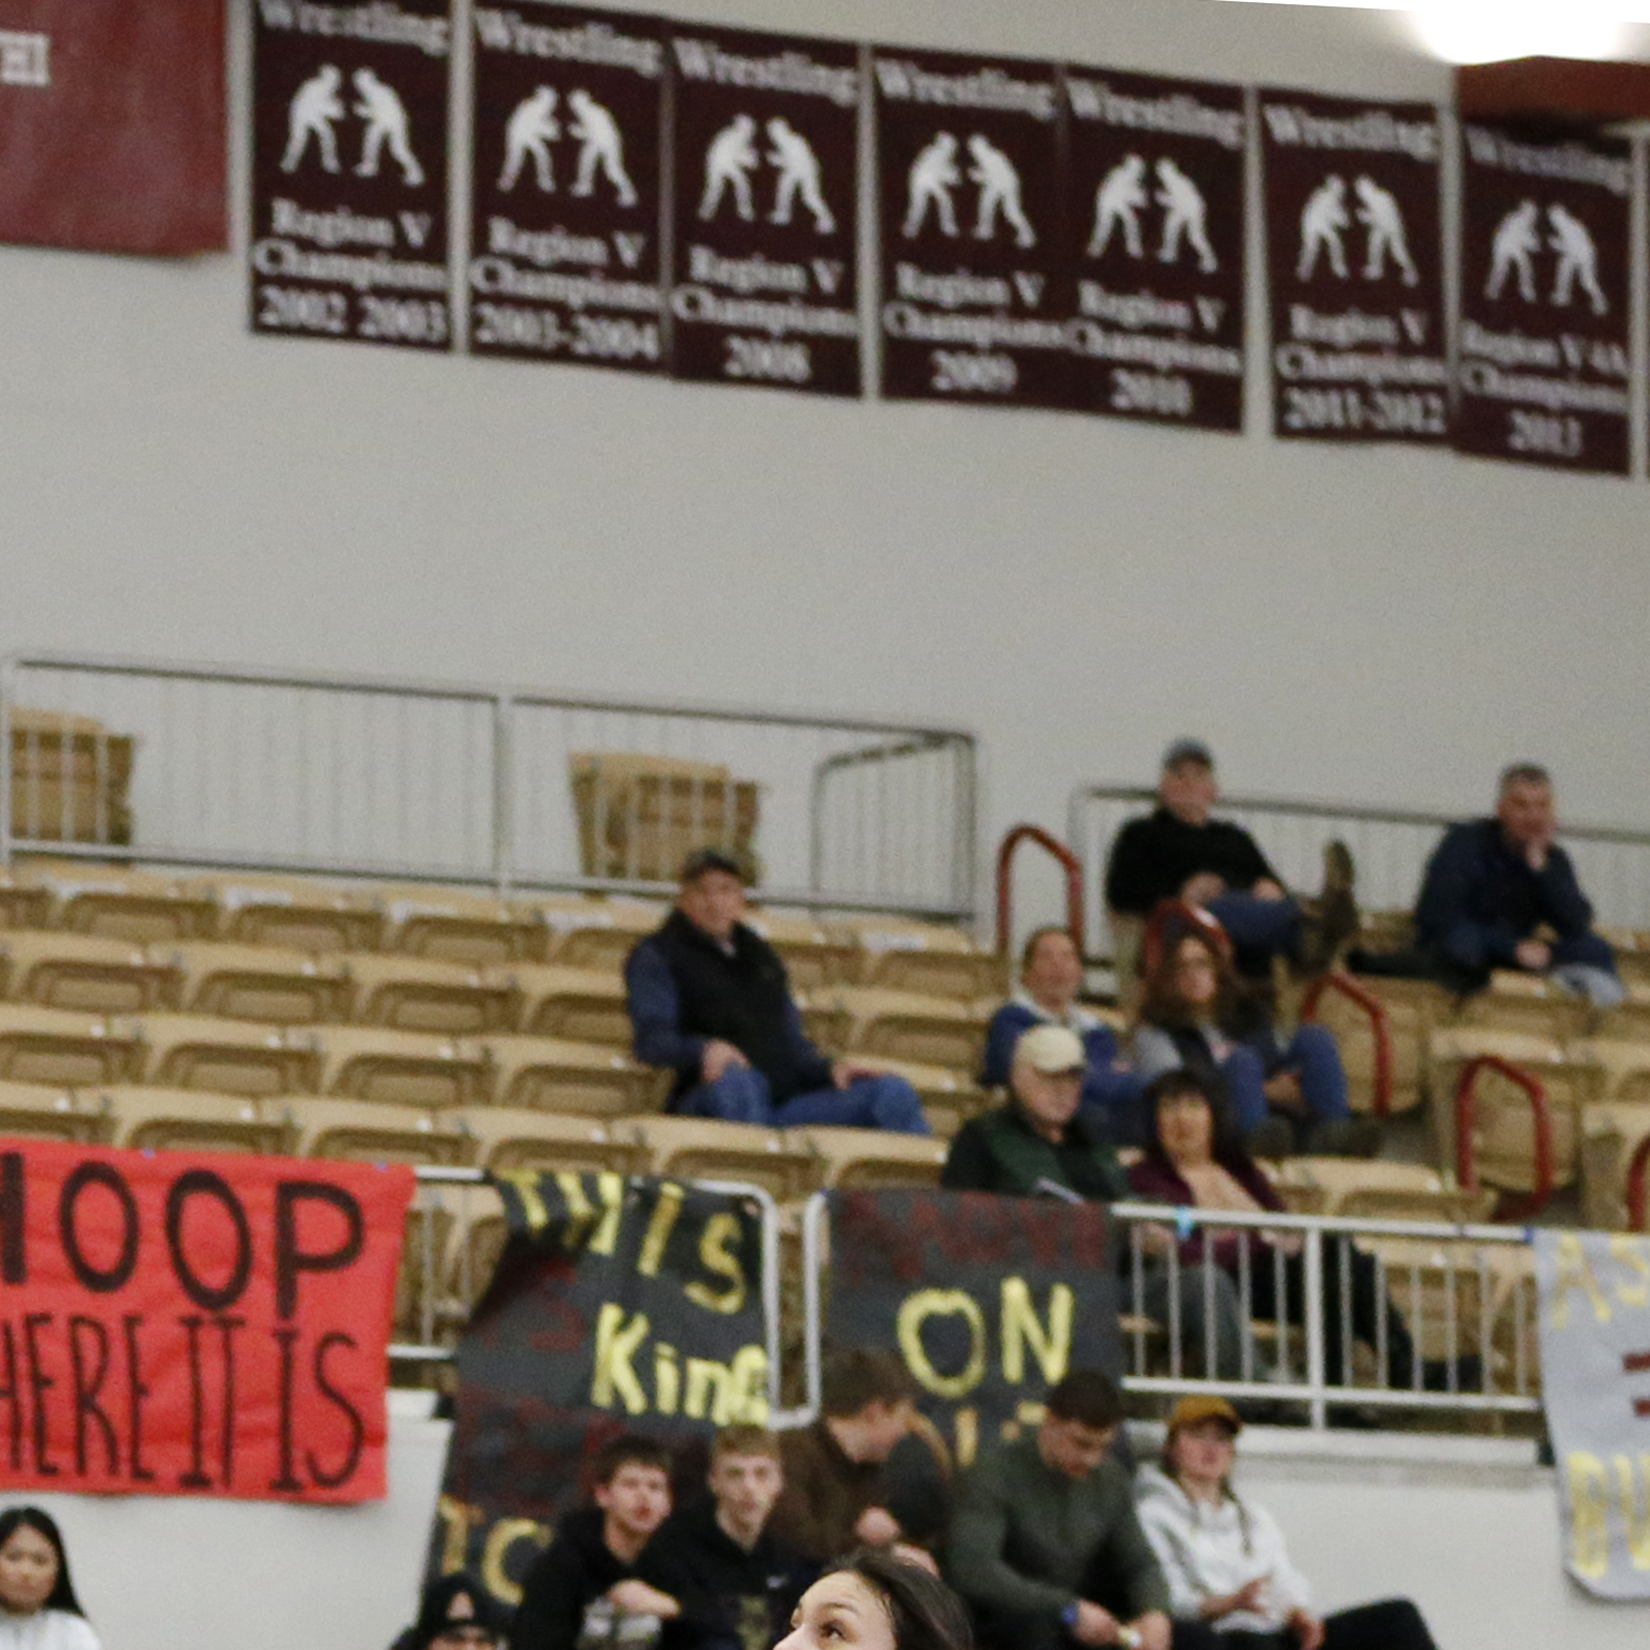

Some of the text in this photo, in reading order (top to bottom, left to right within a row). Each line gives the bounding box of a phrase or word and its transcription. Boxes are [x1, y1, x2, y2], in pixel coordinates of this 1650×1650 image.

[397, 211, 432, 248] V
[612, 230, 645, 268] V
[810, 258, 843, 295] V
[1013, 271, 1046, 308] V
[1195, 296, 1226, 333] V
[1399, 308, 1429, 346] V
[1560, 333, 1584, 371] V
[897, 1275, 1076, 1398] ON
[178, 1313, 246, 1489] IT
[270, 1327, 365, 1492] IS
